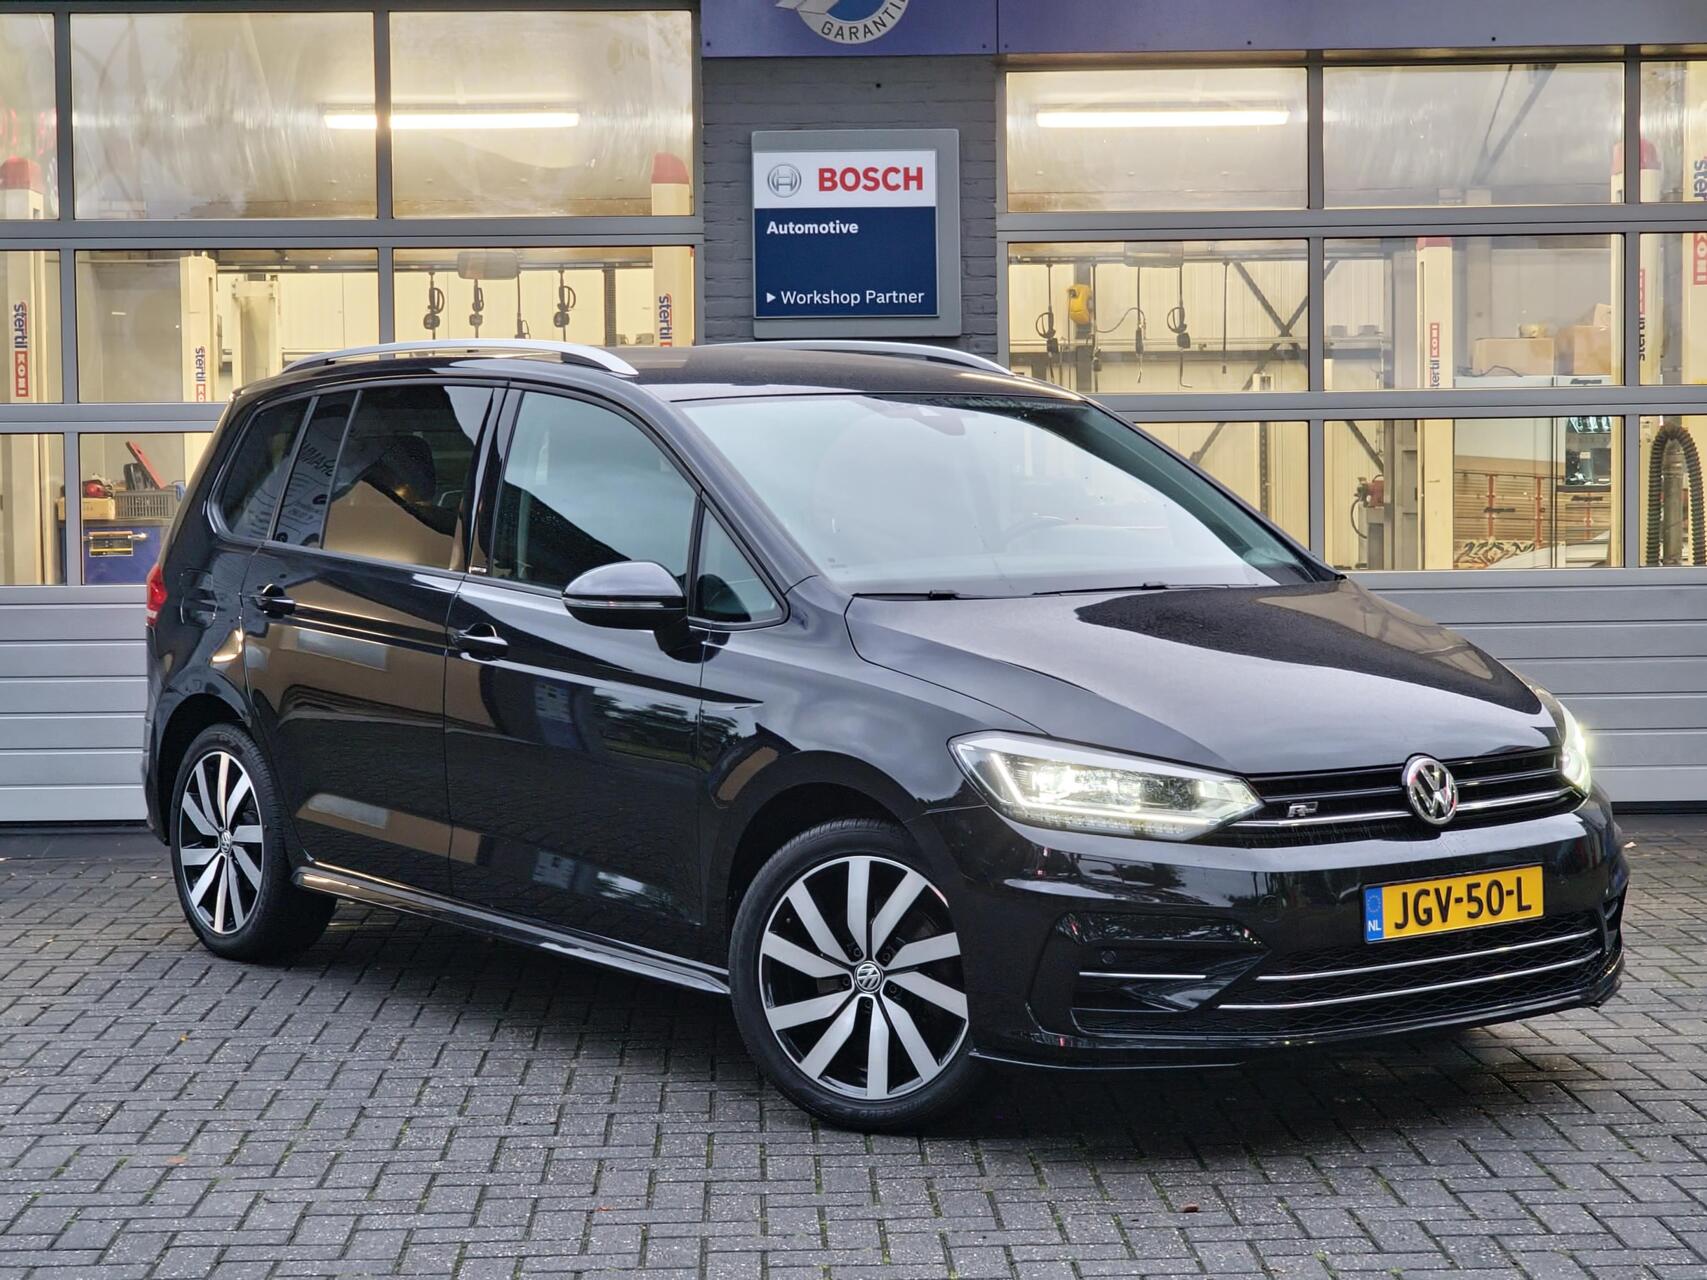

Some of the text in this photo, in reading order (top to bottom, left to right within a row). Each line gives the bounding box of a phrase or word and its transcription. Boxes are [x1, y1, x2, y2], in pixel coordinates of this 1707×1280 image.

[820, 0, 907, 41] GARANTI
[818, 167, 923, 192] BOSCH
[766, 220, 859, 235] Automotive
[780, 290, 925, 306] Workshop Partner
[14, 302, 28, 349] stertil
[659, 294, 673, 340] stertil
[195, 346, 206, 382] stertil
[1394, 876, 1532, 930] JGV-50-L
[1367, 919, 1382, 932] NL
